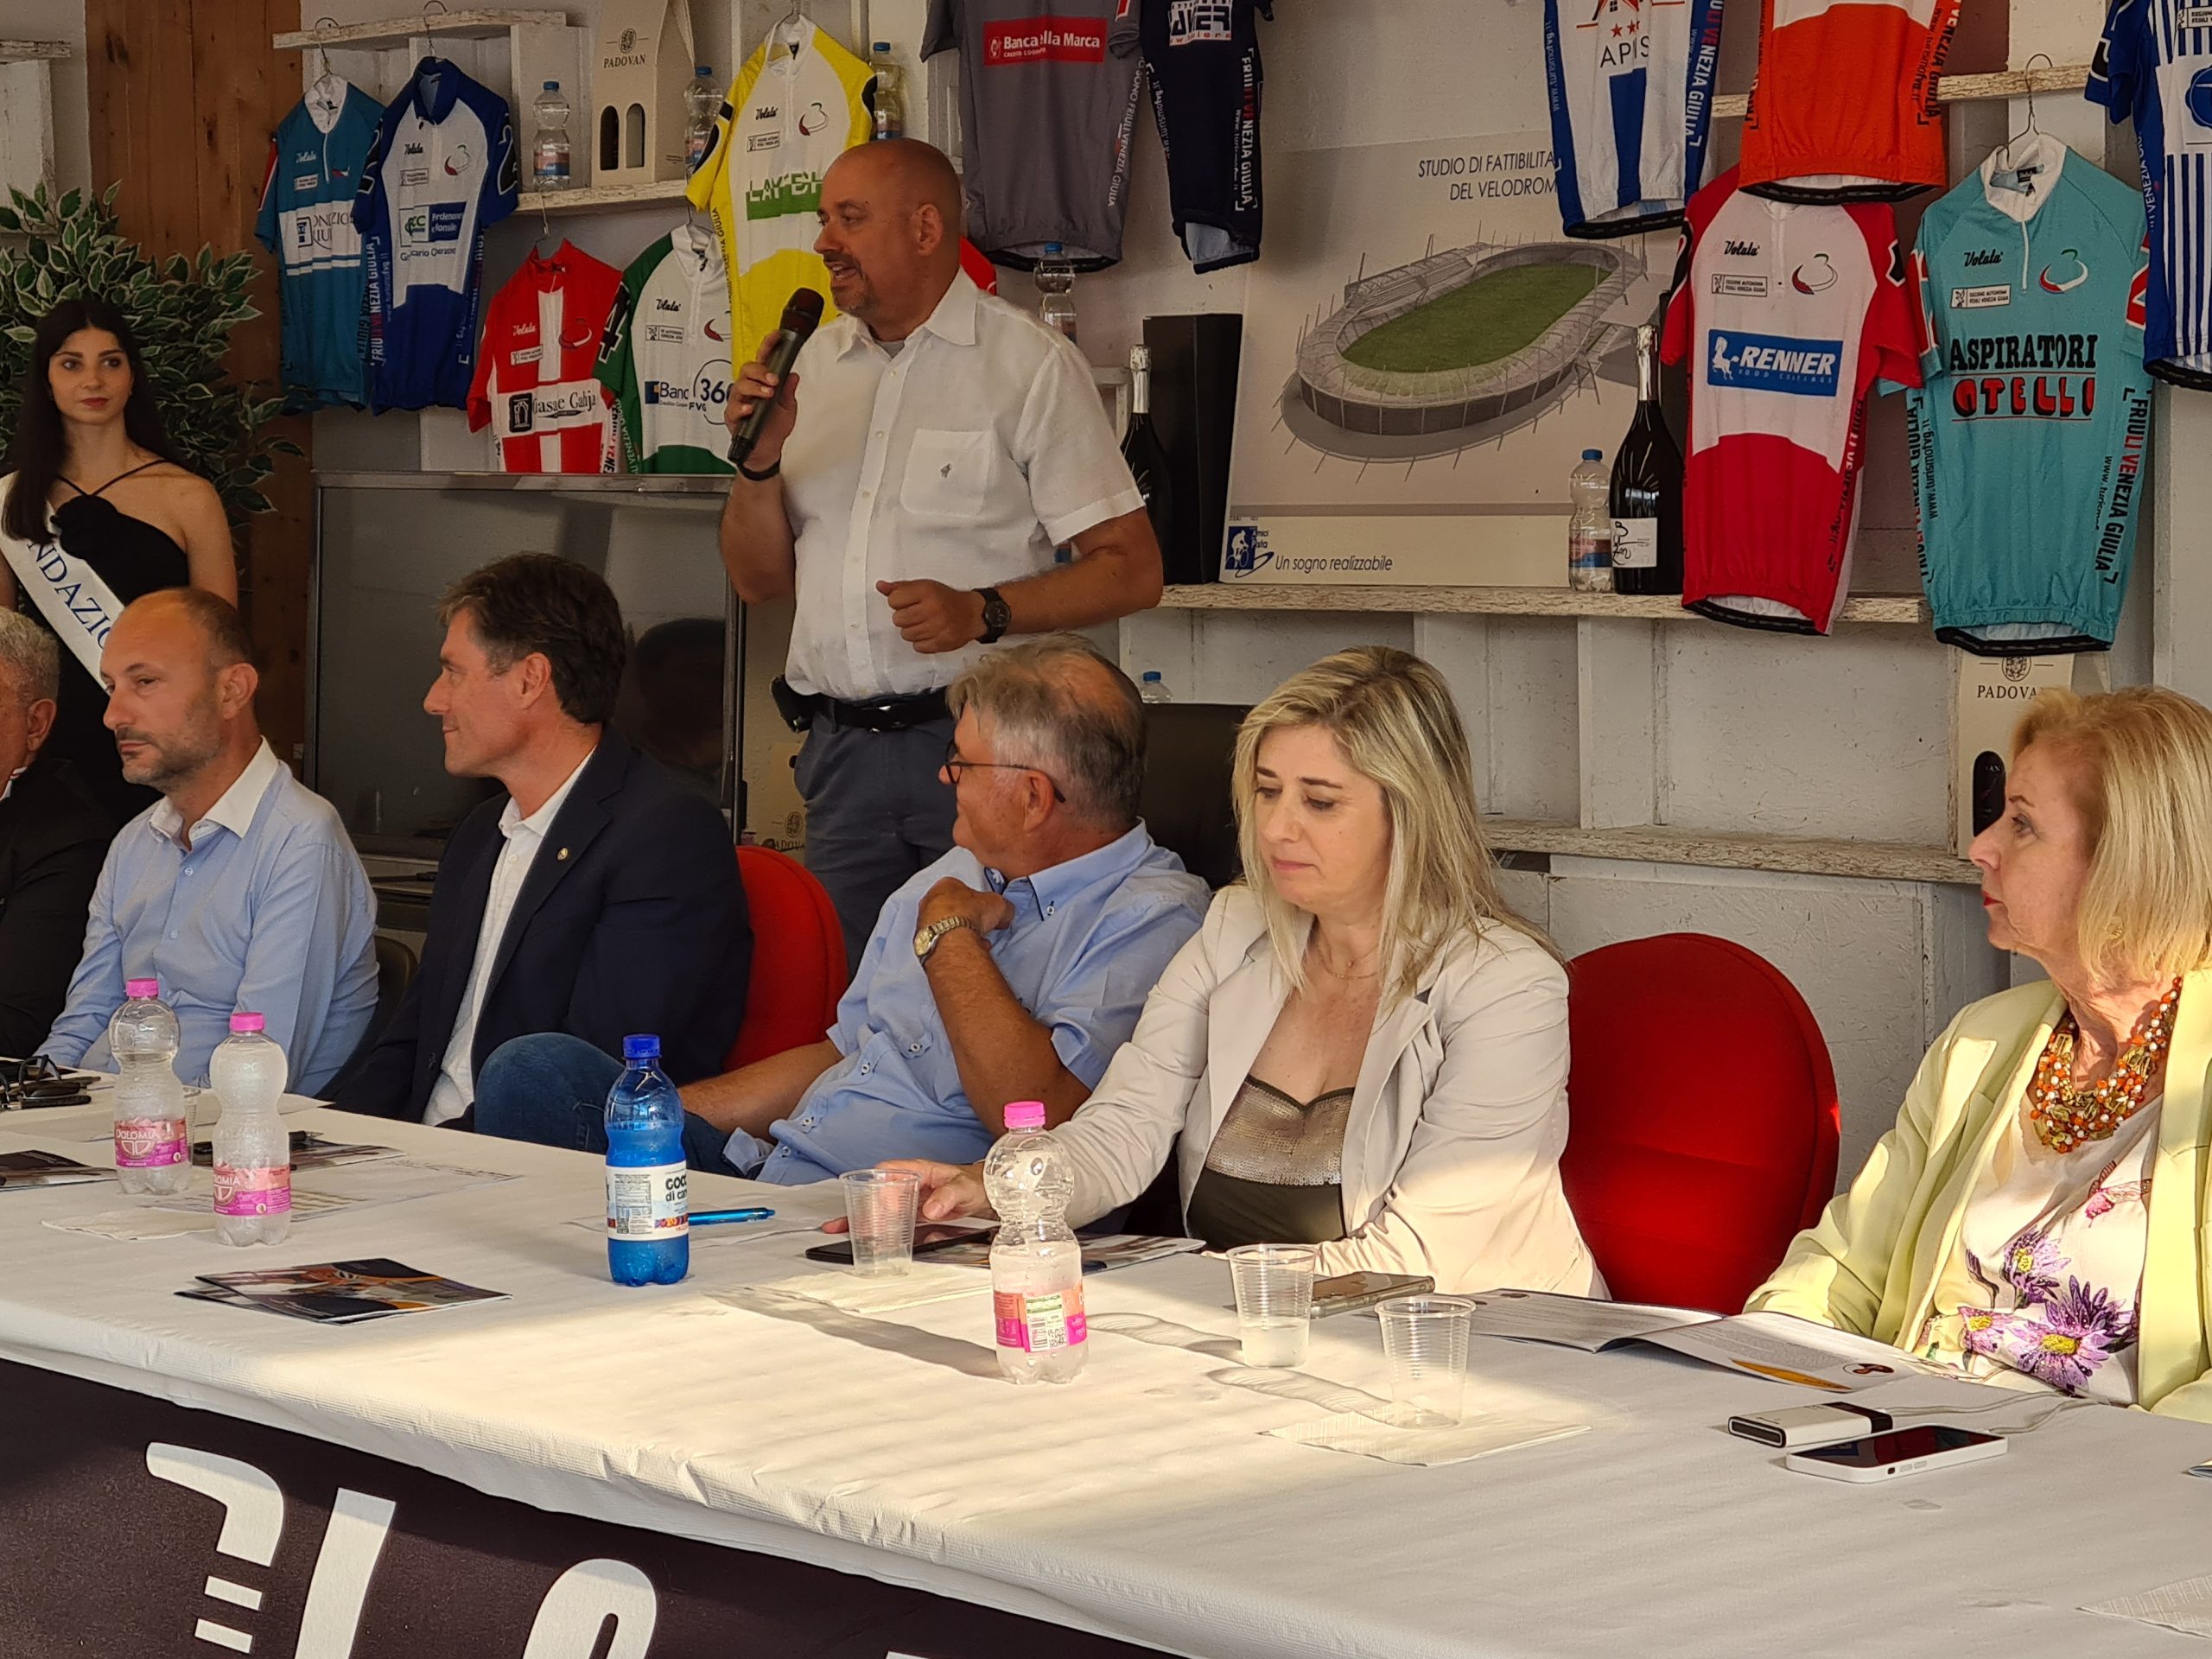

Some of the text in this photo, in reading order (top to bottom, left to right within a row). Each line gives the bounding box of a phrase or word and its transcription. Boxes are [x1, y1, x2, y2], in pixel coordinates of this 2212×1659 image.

[1004, 35, 1039, 49] Banca
[1064, 32, 1100, 48] Marca
[1599, 35, 1649, 68] APIS
[1692, 27, 1722, 86] VENEZIA
[603, 54, 646, 68] PADOVAN
[1924, 9, 1960, 118] VENEZIA GIULIA
[1685, 91, 1705, 137] GIULIA
[1116, 130, 1130, 174] VENEZIA
[1418, 157, 1465, 177] STUDIO
[1469, 156, 1483, 173] DI
[1107, 175, 1122, 207] GIULIA
[1241, 162, 1253, 205] GIULIA
[1450, 176, 1556, 200] DEL VELODROM
[2140, 159, 2156, 215] VENEZIA
[365, 243, 379, 280] GIULIA
[1739, 345, 1837, 375] RENNER
[1949, 334, 2098, 372] ASPIRATORI
[1953, 377, 2095, 417] OTELLI
[1906, 407, 1921, 461] GIULIA
[2094, 397, 2149, 571] FRIULI VENEZIA GIULIA
[1275, 555, 1394, 575] Un sogno realizzabile
[116, 1128, 162, 1141] DOLOMIA
[665, 1191, 675, 1202] di
